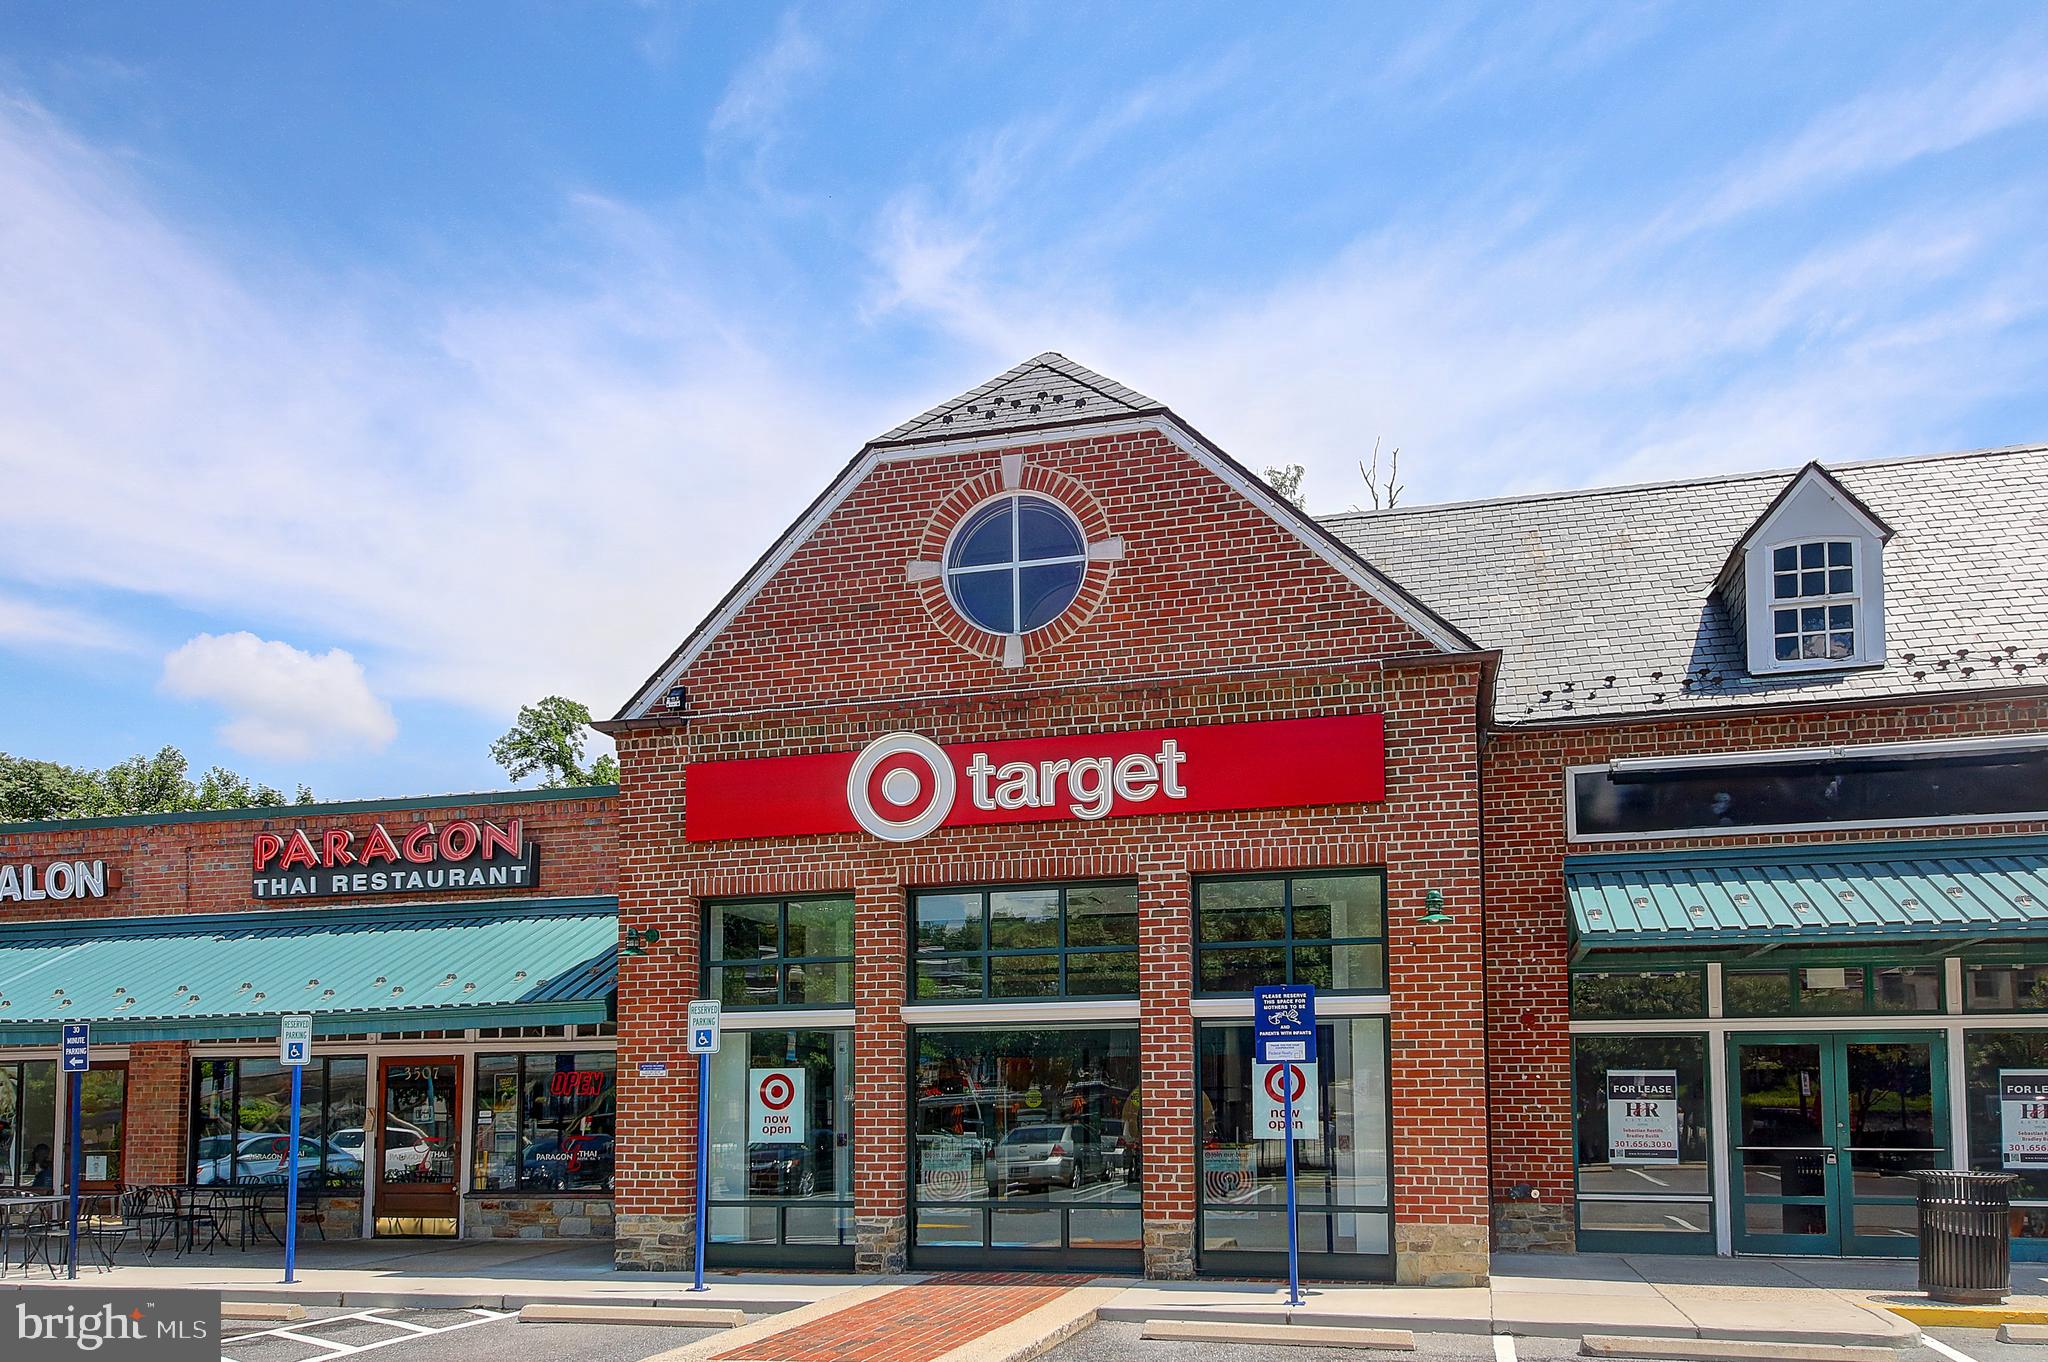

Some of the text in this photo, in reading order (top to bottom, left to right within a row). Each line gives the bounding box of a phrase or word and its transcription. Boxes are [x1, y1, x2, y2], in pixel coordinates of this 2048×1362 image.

[966, 739, 1187, 820] target
[253, 818, 522, 873] PARAGON
[0, 859, 104, 902] ALON
[254, 865, 527, 897] THAI RESTAURANT
[690, 1005, 718, 1014] RESERVED
[284, 1020, 309, 1028] RESERVED
[692, 1016, 716, 1026] PARKING
[72, 1026, 80, 1034] 30
[286, 1031, 307, 1039] PARKING
[65, 1047, 87, 1055] PARKING
[404, 1066, 440, 1080] 3507
[550, 1071, 604, 1096] OPEN
[1613, 1085, 1672, 1093] FOR LEASE
[2007, 1085, 2032, 1094] FOR
[764, 1115, 789, 1124] now
[762, 1125, 792, 1136] open
[1615, 1140, 1672, 1148] 301.656.3030
[430, 1150, 448, 1158] THAI
[536, 1153, 573, 1161] PARAGON
